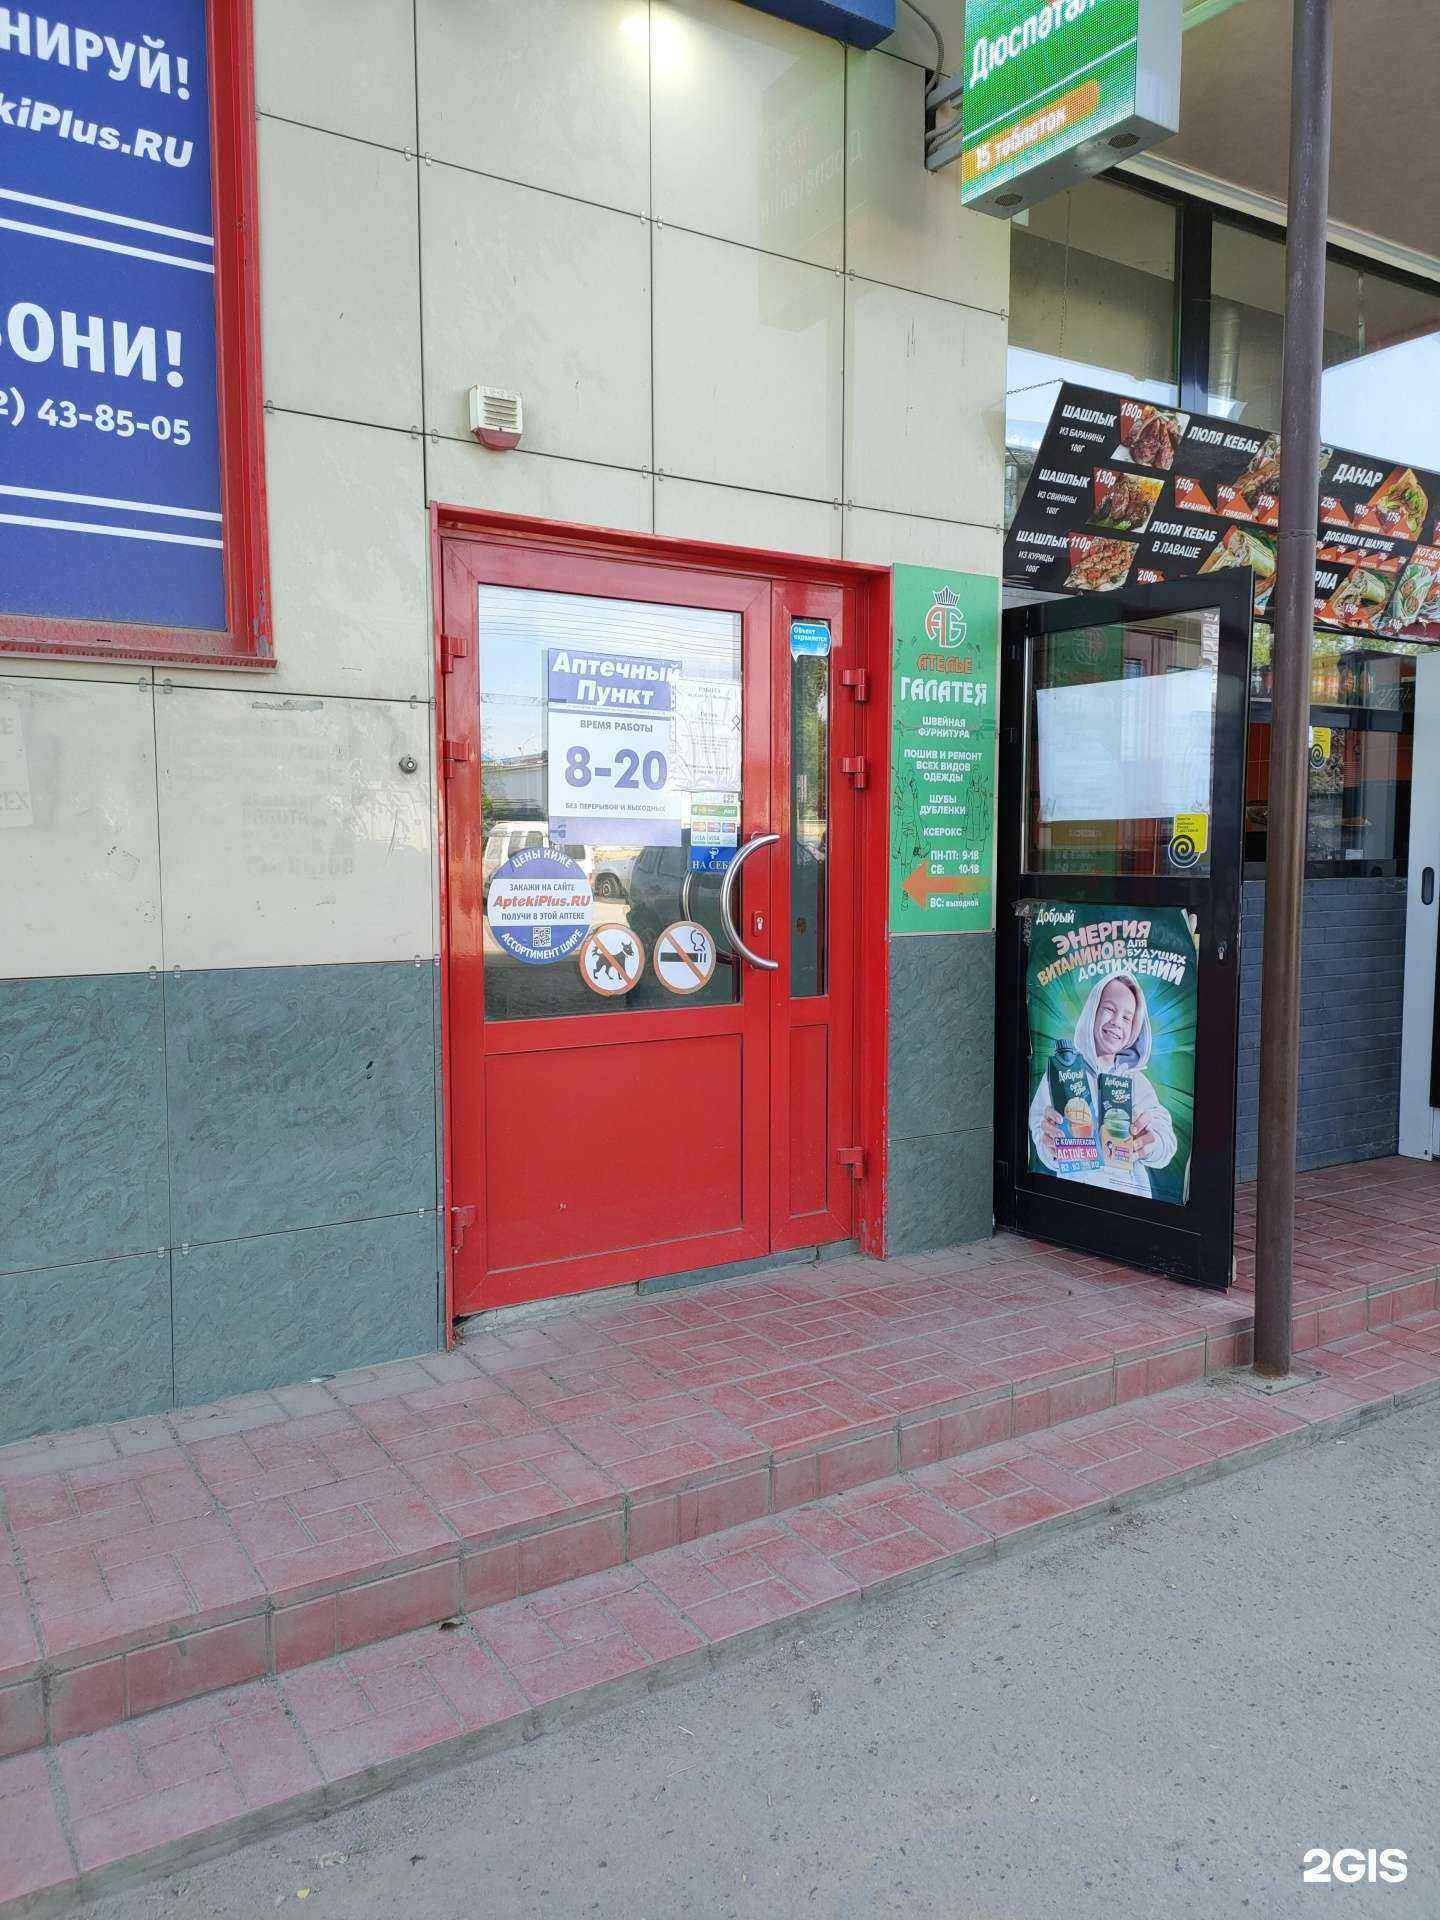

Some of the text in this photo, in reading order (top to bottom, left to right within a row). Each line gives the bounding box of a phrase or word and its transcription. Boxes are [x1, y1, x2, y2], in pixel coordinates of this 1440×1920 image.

[969, 0, 1097, 88] Дюспата
[0, 302, 185, 388] ОНИ!
[37, 398, 192, 447] 43-85-05
[1062, 404, 1117, 428] ШАШЛЫК
[1059, 426, 1106, 443] ИЗ БАРАНИНЫ
[1187, 425, 1260, 454] ЛЮЛЯ КЕБАБ
[1039, 469, 1090, 488] ШАШЛЫК
[1332, 463, 1383, 487] ДАНАР
[1037, 490, 1046, 498] ИЗ
[1016, 530, 1069, 548] ШАШЛЫК
[1150, 521, 1218, 542] ЛЮЛЯ КЕБАБ
[1323, 530, 1359, 546] ДОБАВКИ
[1018, 550, 1028, 558] ИЗ
[1152, 541, 1202, 559] В ЛАВАШЕ
[552, 652, 682, 685] Аптечный
[917, 653, 973, 674] АТЕЛЬЕ
[576, 679, 655, 706] Пункт
[900, 676, 988, 706] ГАЛАТЕЯ
[580, 719, 654, 733] ВРЕМЯ РАБОТЫ
[922, 715, 966, 727] ШВЕЙНАЯ
[918, 727, 970, 739] ФУРНИТУРА
[904, 748, 983, 761] ПОШИВ И РЕМОНТ
[564, 745, 668, 791] 8-20
[916, 760, 971, 772] ВСЕХ ВИДОВ
[923, 772, 963, 783] ОДЕЖДЫ
[929, 794, 957, 804] ШУБЫ
[919, 805, 966, 816] ДУБЛЕНКИ
[923, 827, 963, 837] КСЕРОКС
[512, 849, 572, 869] ЦЕНЫ НИЖЕ
[930, 850, 979, 861] ПН-ПТ: 9-18
[692, 860, 731, 870] НА СЕБ
[930, 864, 980, 874] СБ: 10-18
[509, 881, 575, 892] ЗАКАЖИ НА САЙТЕ
[493, 895, 592, 909] AptekiPlus.RU
[930, 897, 979, 908] ВС: выходной
[501, 910, 585, 921] ПОЛУЧИ В ЭТОЙ АПТЕКЕ
[1036, 908, 1077, 926] Добрый
[501, 928, 584, 961] АССОРТИМЕНТ ШИРЕ
[1052, 920, 1151, 955] ЭНЕРГИЯ
[1127, 939, 1147, 949] ДЛЯ
[1037, 940, 1127, 986] ВИТАМИНОВ
[1078, 958, 1186, 986] ДОСТИЖЕНИЙ
[1057, 1148, 1086, 1160] ACTIVE
